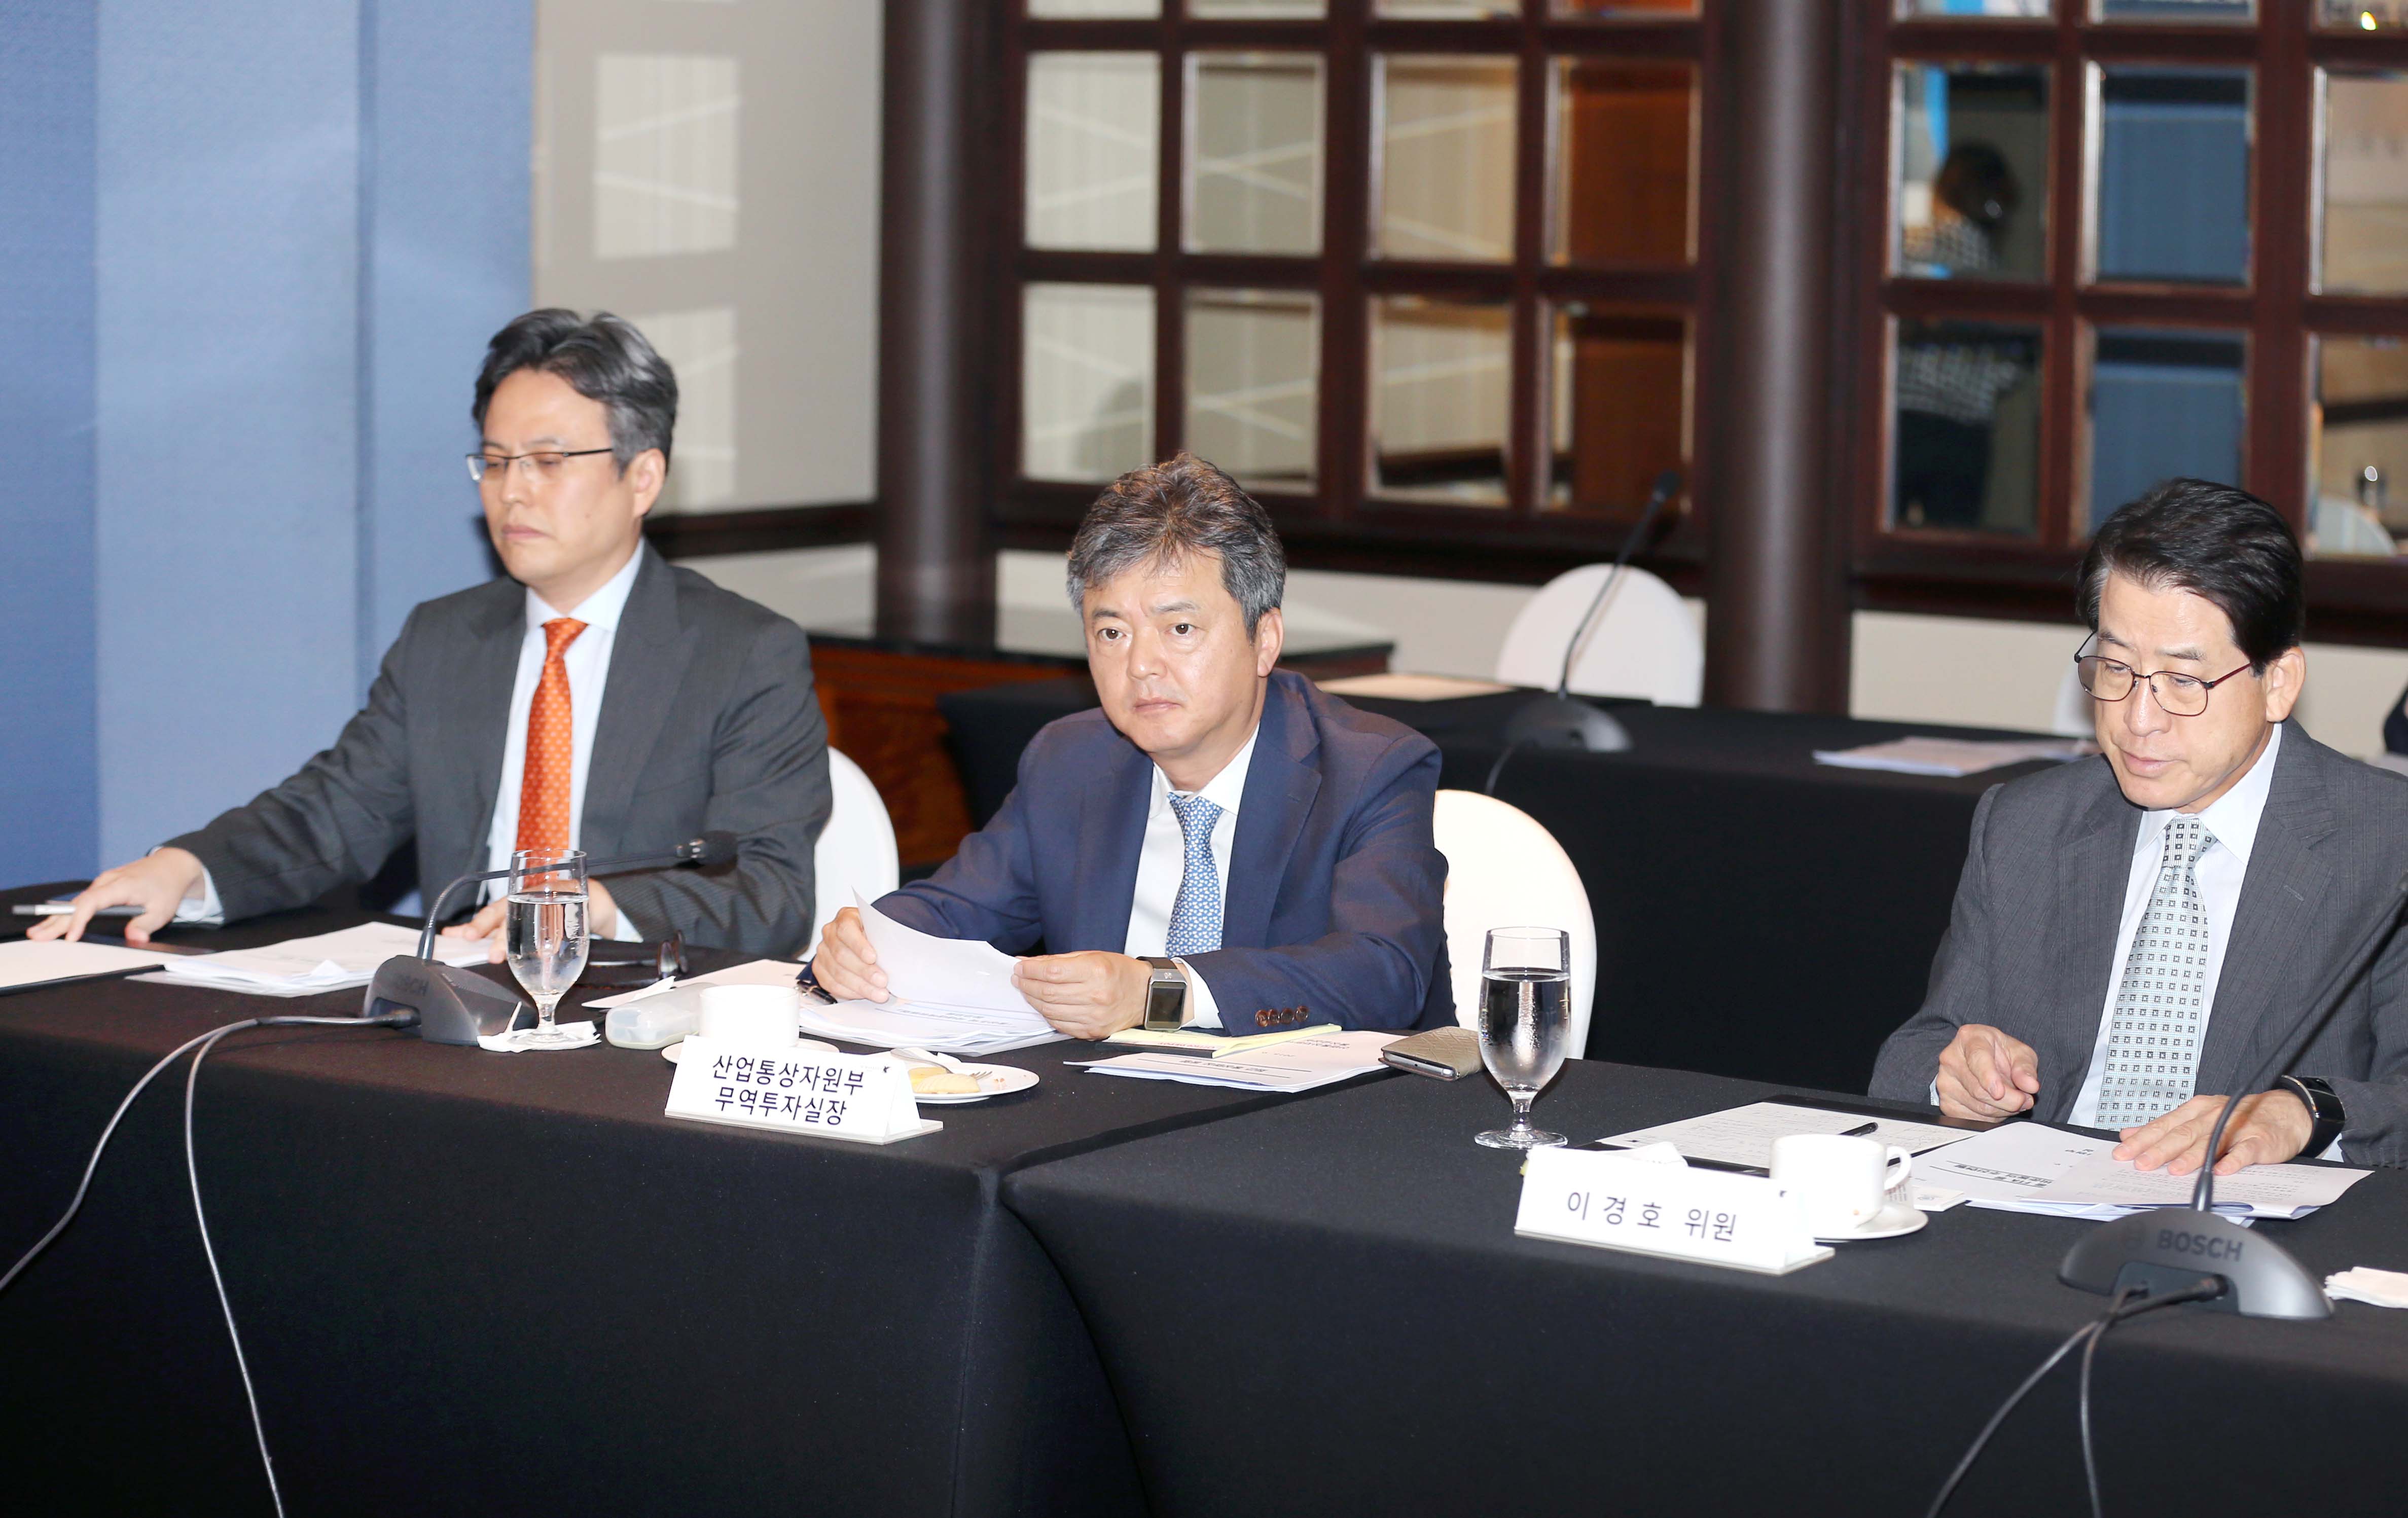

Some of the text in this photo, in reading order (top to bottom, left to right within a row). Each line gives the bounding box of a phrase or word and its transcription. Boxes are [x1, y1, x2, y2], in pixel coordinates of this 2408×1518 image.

[712, 1055, 865, 1096] 산업통상자원부
[714, 1086, 847, 1126] 무역투자실장
[1567, 1191, 1737, 1243] 이 경 호 위원
[2158, 1228, 2244, 1262] BOSCH
